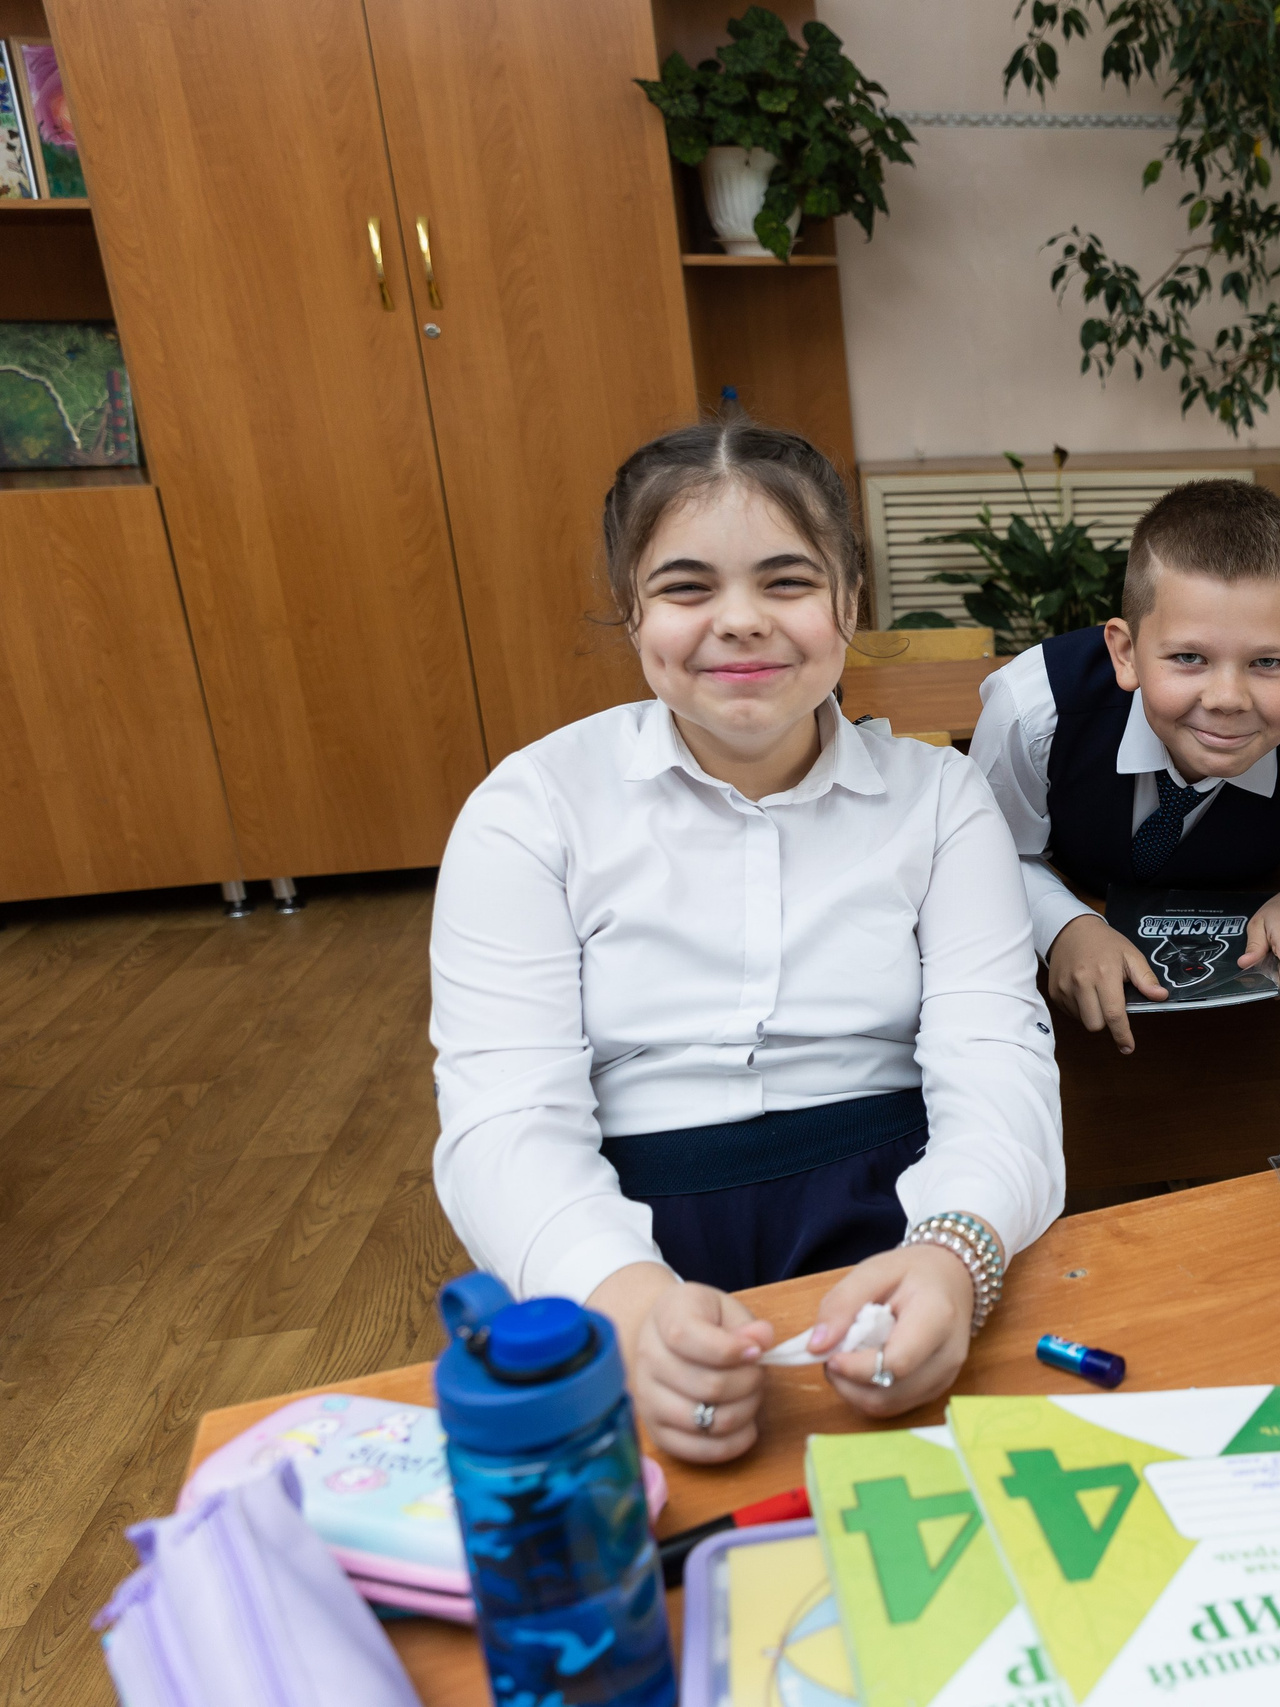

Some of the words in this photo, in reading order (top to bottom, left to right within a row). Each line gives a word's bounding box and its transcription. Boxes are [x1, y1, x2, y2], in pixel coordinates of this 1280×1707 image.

[1144, 918, 1243, 935] HACKER
[839, 1475, 985, 1626] 4
[999, 1448, 1141, 1583] 4
